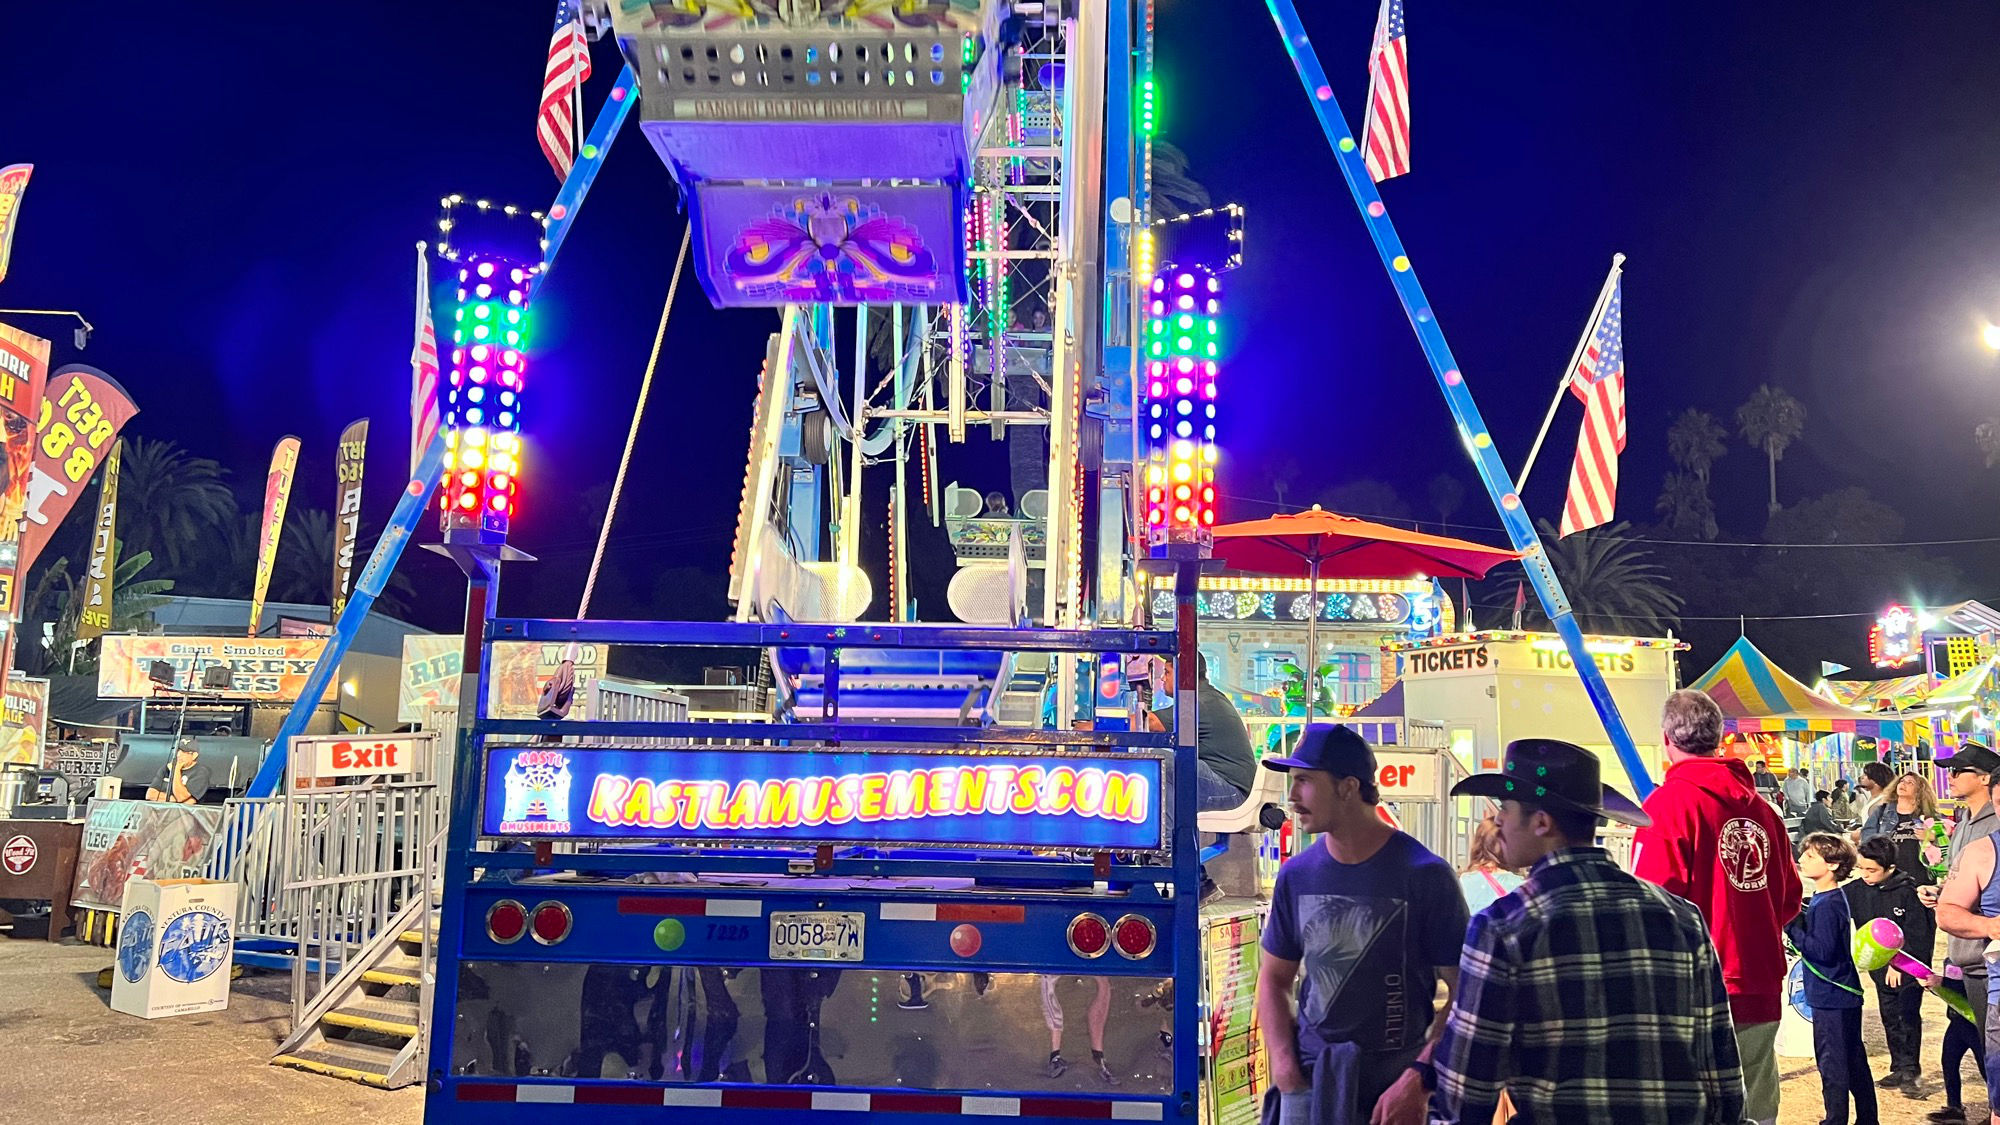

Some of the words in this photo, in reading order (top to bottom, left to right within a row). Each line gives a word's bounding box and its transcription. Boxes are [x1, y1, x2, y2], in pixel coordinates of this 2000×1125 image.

[0, 349, 30, 382] ORK
[1288, 593, 1401, 620] GRAS
[171, 644, 213, 655] Giant
[224, 645, 285, 656] Smoked
[1410, 647, 1489, 674] TICKETS
[1531, 648, 1634, 672] TICETS
[172, 675, 280, 693] LGS
[5, 694, 36, 715] OLISH
[331, 742, 399, 769] Exit
[517, 751, 564, 768] KASTL
[587, 765, 1149, 830] KASTLAMUSEMENTS.COM
[499, 820, 571, 833] AMUSEMENTS
[161, 906, 193, 930] VENTURA
[194, 905, 225, 918] COUNTY
[776, 923, 824, 946] 0058
[835, 922, 859, 948] 7W
[1384, 973, 1405, 1044] O'NEILL
